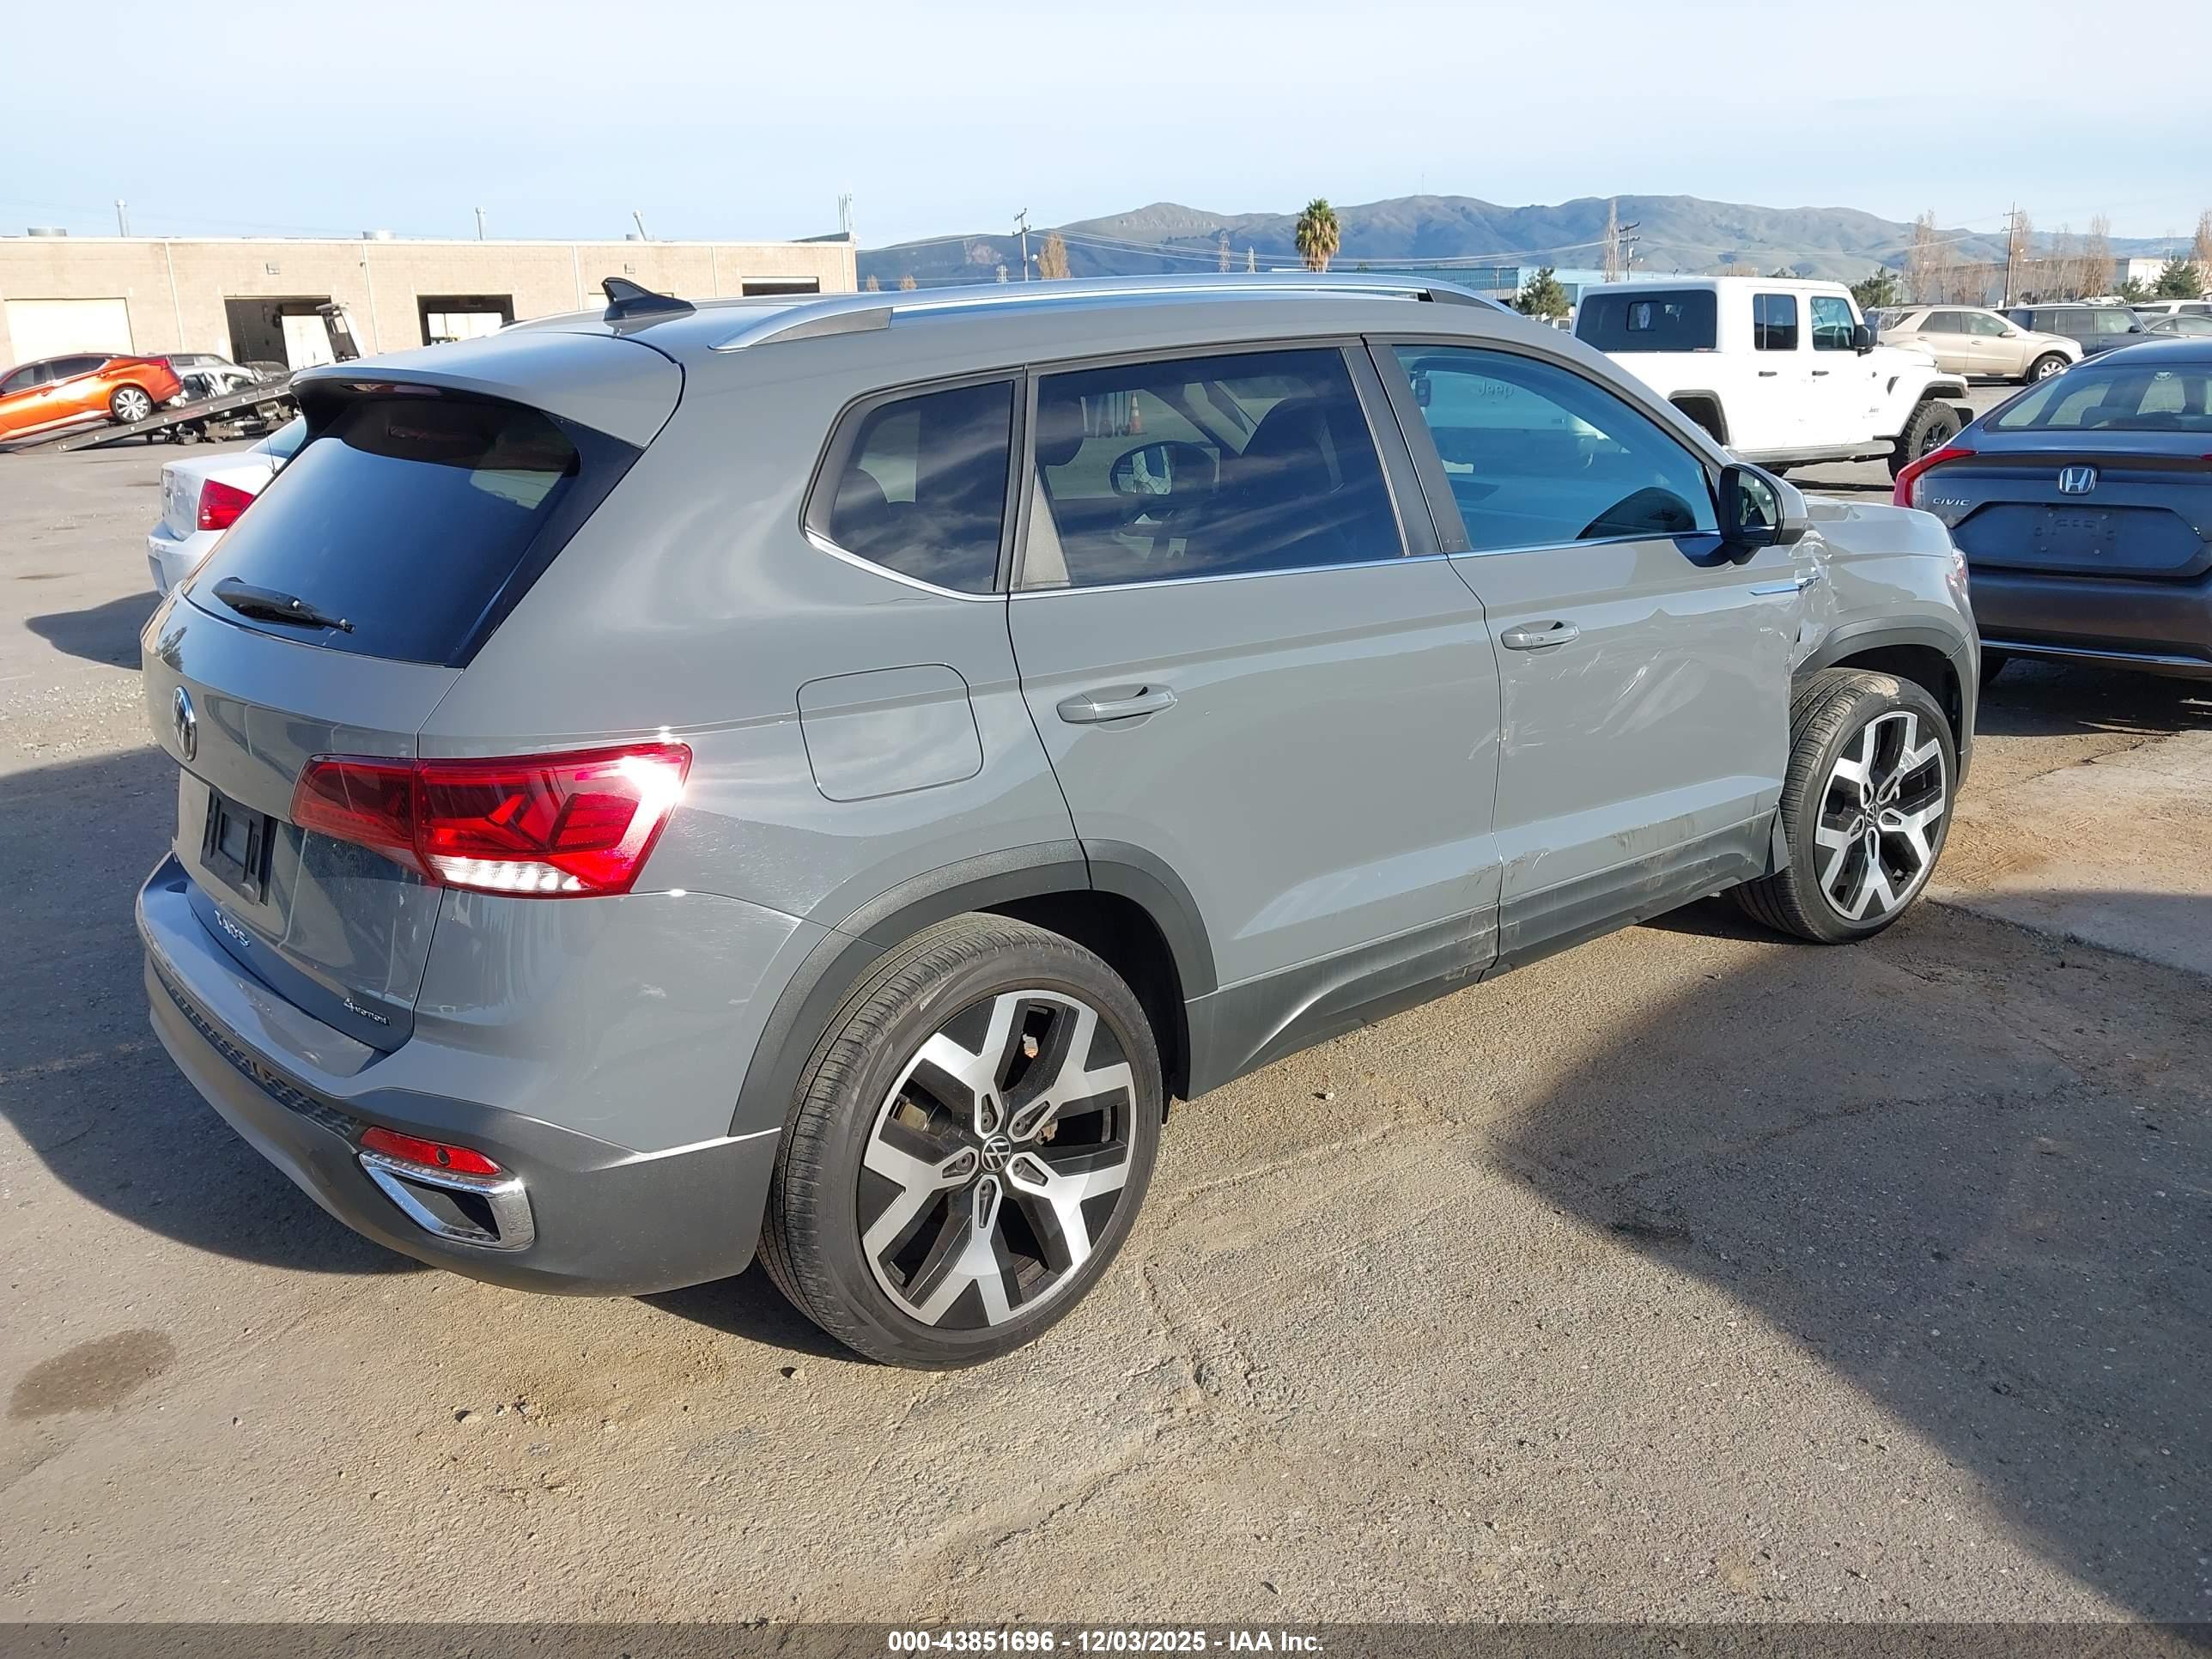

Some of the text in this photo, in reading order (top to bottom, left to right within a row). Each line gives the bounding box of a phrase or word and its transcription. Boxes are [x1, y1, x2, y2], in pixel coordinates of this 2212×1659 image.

[1479, 380, 1515, 399] Jeep
[1932, 497, 1972, 507] CIVIC
[214, 908, 251, 948] TAOS
